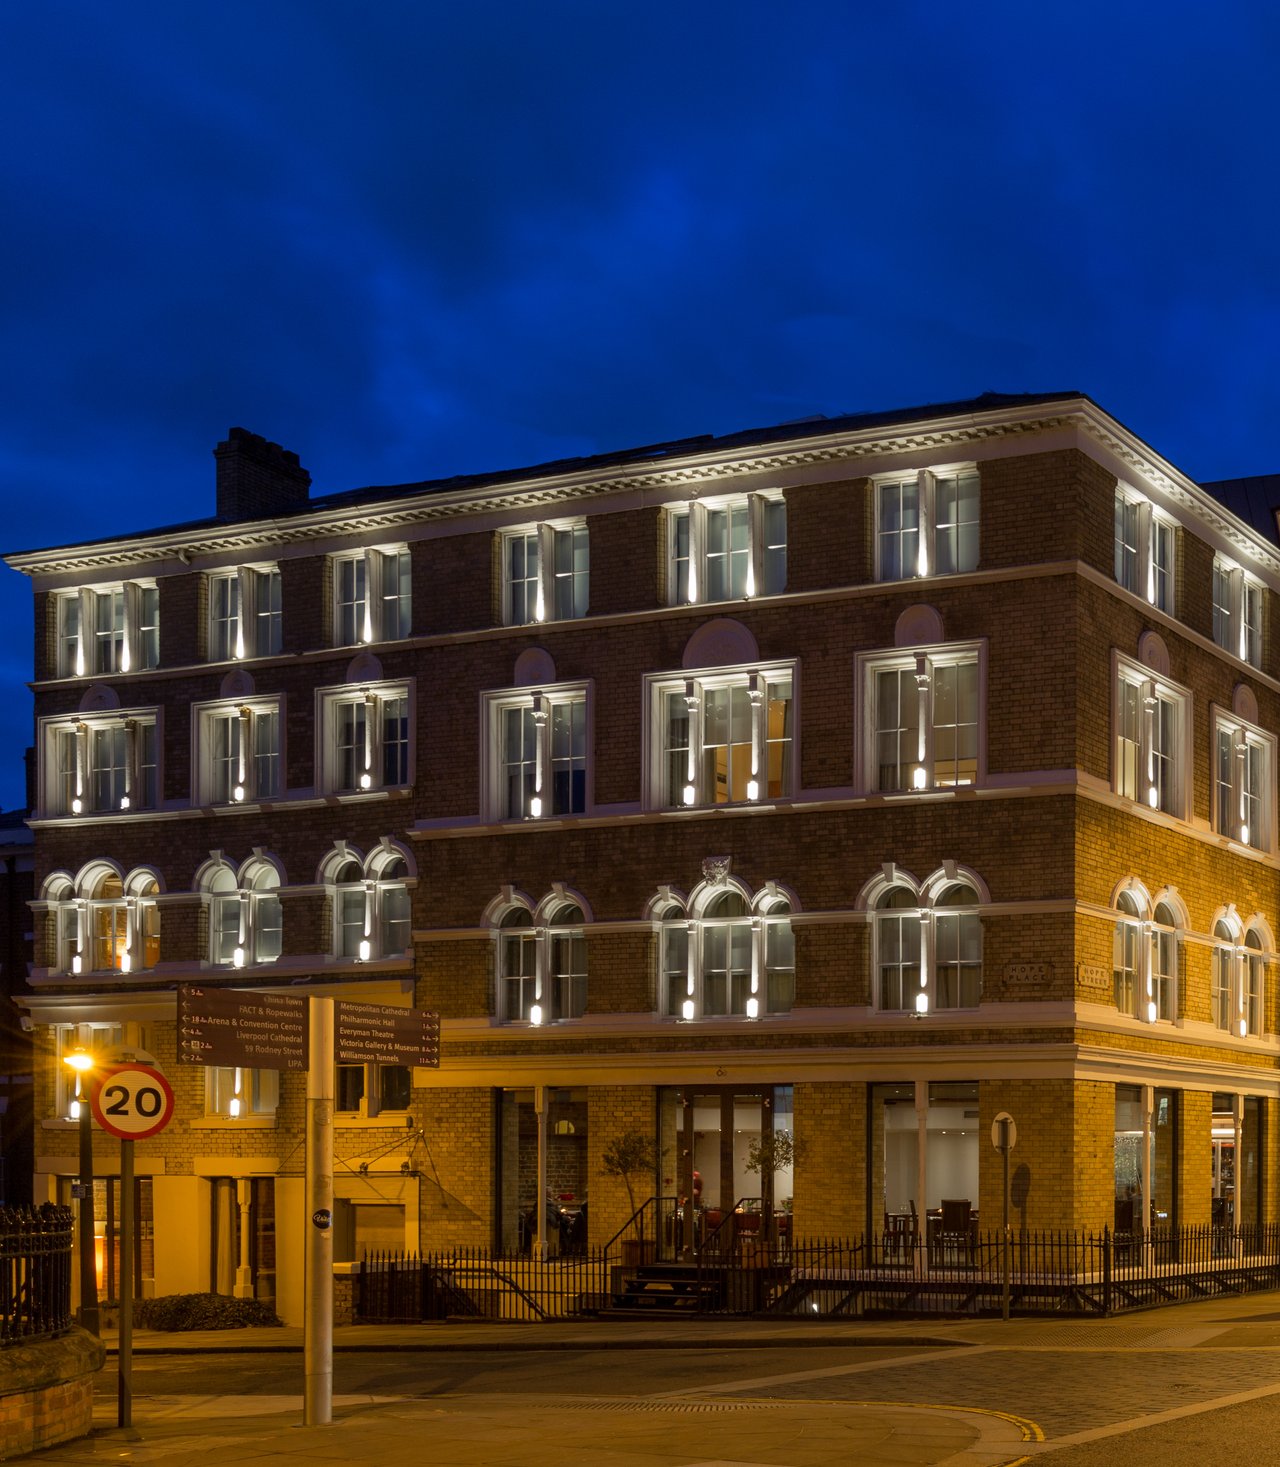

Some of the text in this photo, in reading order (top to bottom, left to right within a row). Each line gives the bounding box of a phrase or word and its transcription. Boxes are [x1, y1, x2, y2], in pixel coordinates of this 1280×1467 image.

[1084, 969, 1105, 978] HOPE
[1081, 976, 1107, 987] STREET
[285, 997, 303, 1006] Town
[239, 1006, 303, 1018] FACT & Ropewalks
[340, 1003, 410, 1016] Metropolitan Cathedral
[207, 1017, 303, 1032] Arena & Convention Centre
[340, 1014, 395, 1027] Philharmonic Hall
[236, 1031, 303, 1043] Liverpool Cathedral
[339, 1027, 395, 1039] Everyman Theatre
[244, 1045, 303, 1056] 59 Rodney Street
[339, 1038, 364, 1048] Victoria
[364, 1040, 387, 1051] Gallery
[394, 1043, 420, 1052] Museum
[339, 1050, 400, 1063] Williamson Tunnels
[287, 1060, 303, 1068] LIPA
[105, 1085, 162, 1118] 20
